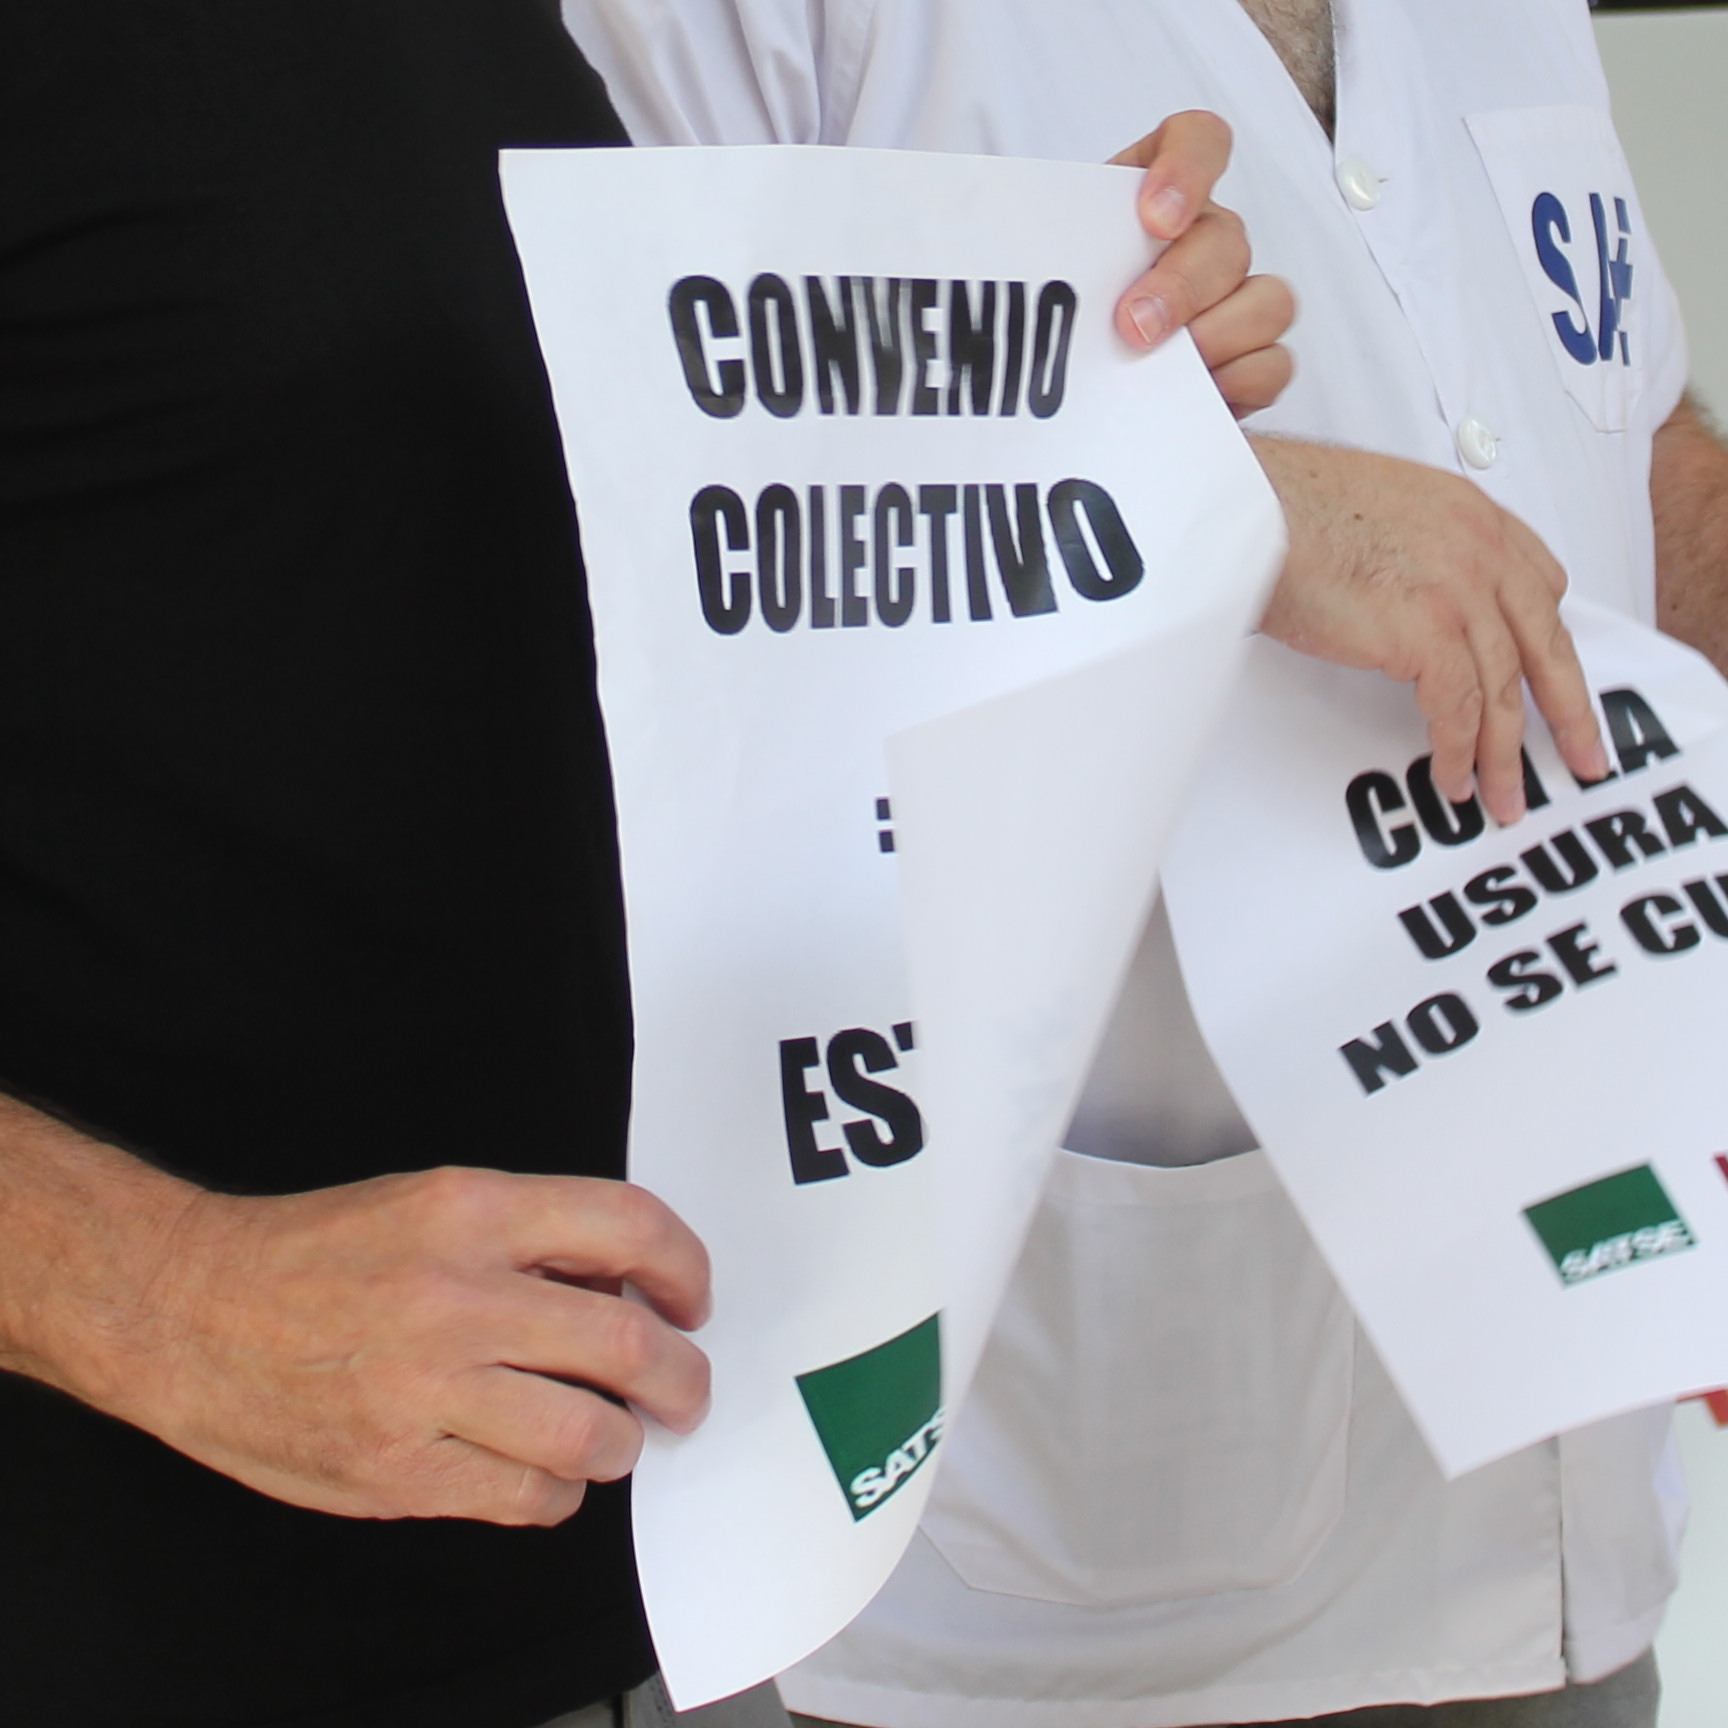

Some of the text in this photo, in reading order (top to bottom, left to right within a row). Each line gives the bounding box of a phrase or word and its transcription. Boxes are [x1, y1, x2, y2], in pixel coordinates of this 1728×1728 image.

[667, 273, 1078, 420] CONVENIO
[689, 478, 1144, 635] COLECTIVO
[1337, 992, 1481, 1097] NO
[1488, 922, 1620, 1013] SE
[778, 1020, 925, 1186] ES
